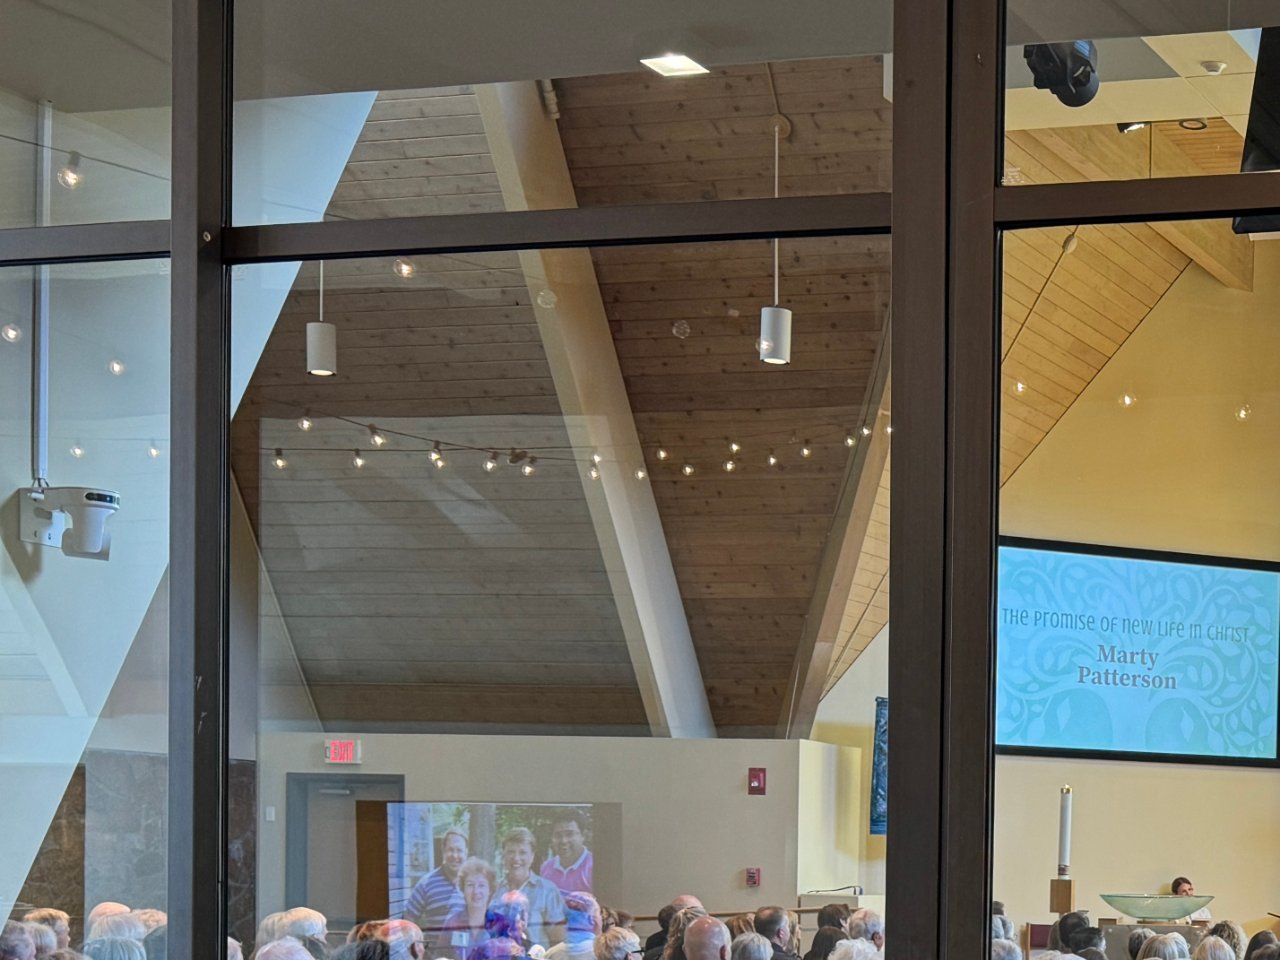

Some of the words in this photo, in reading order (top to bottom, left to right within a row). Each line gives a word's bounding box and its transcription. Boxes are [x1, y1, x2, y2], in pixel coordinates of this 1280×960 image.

[1096, 644, 1159, 670] Marty
[1077, 666, 1177, 690] Patterson
[330, 741, 353, 762] EXIT
